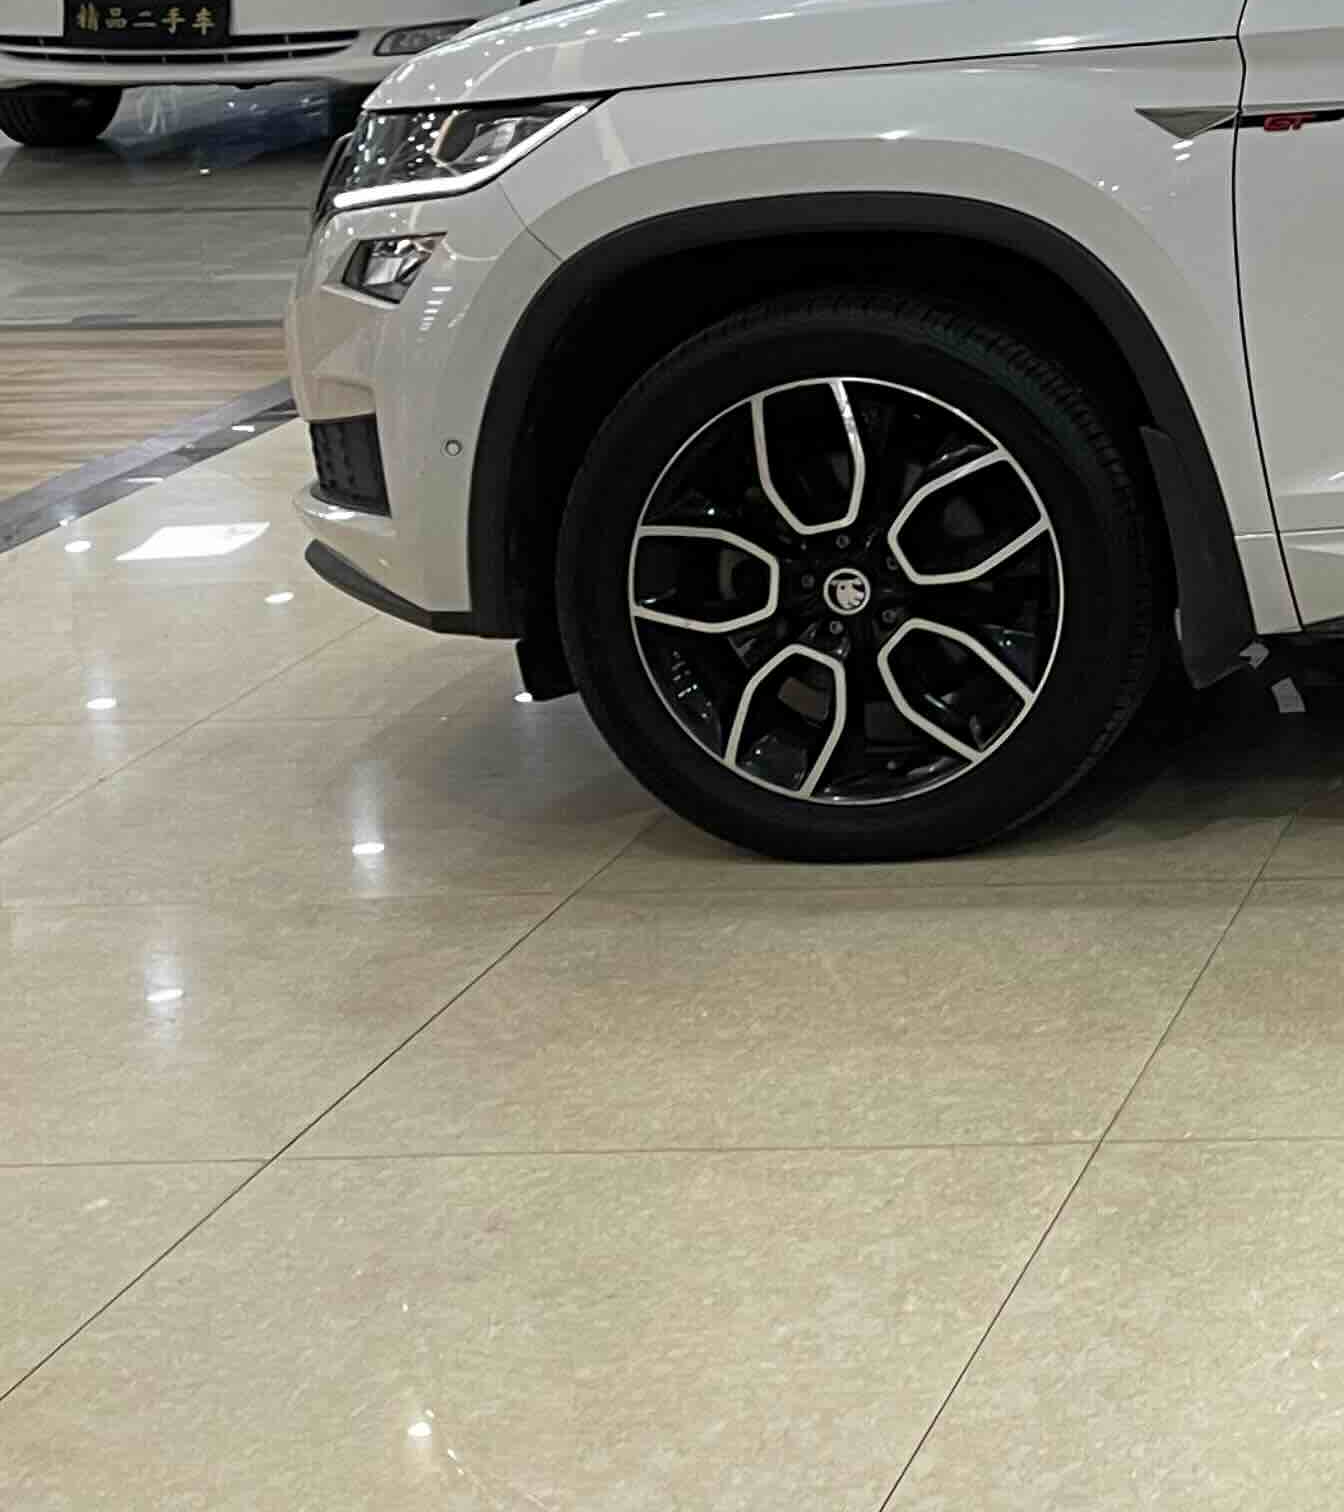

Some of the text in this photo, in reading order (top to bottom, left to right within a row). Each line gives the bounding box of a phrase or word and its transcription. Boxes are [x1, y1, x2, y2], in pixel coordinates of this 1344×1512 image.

[76, 1, 216, 36] 精品二手车
